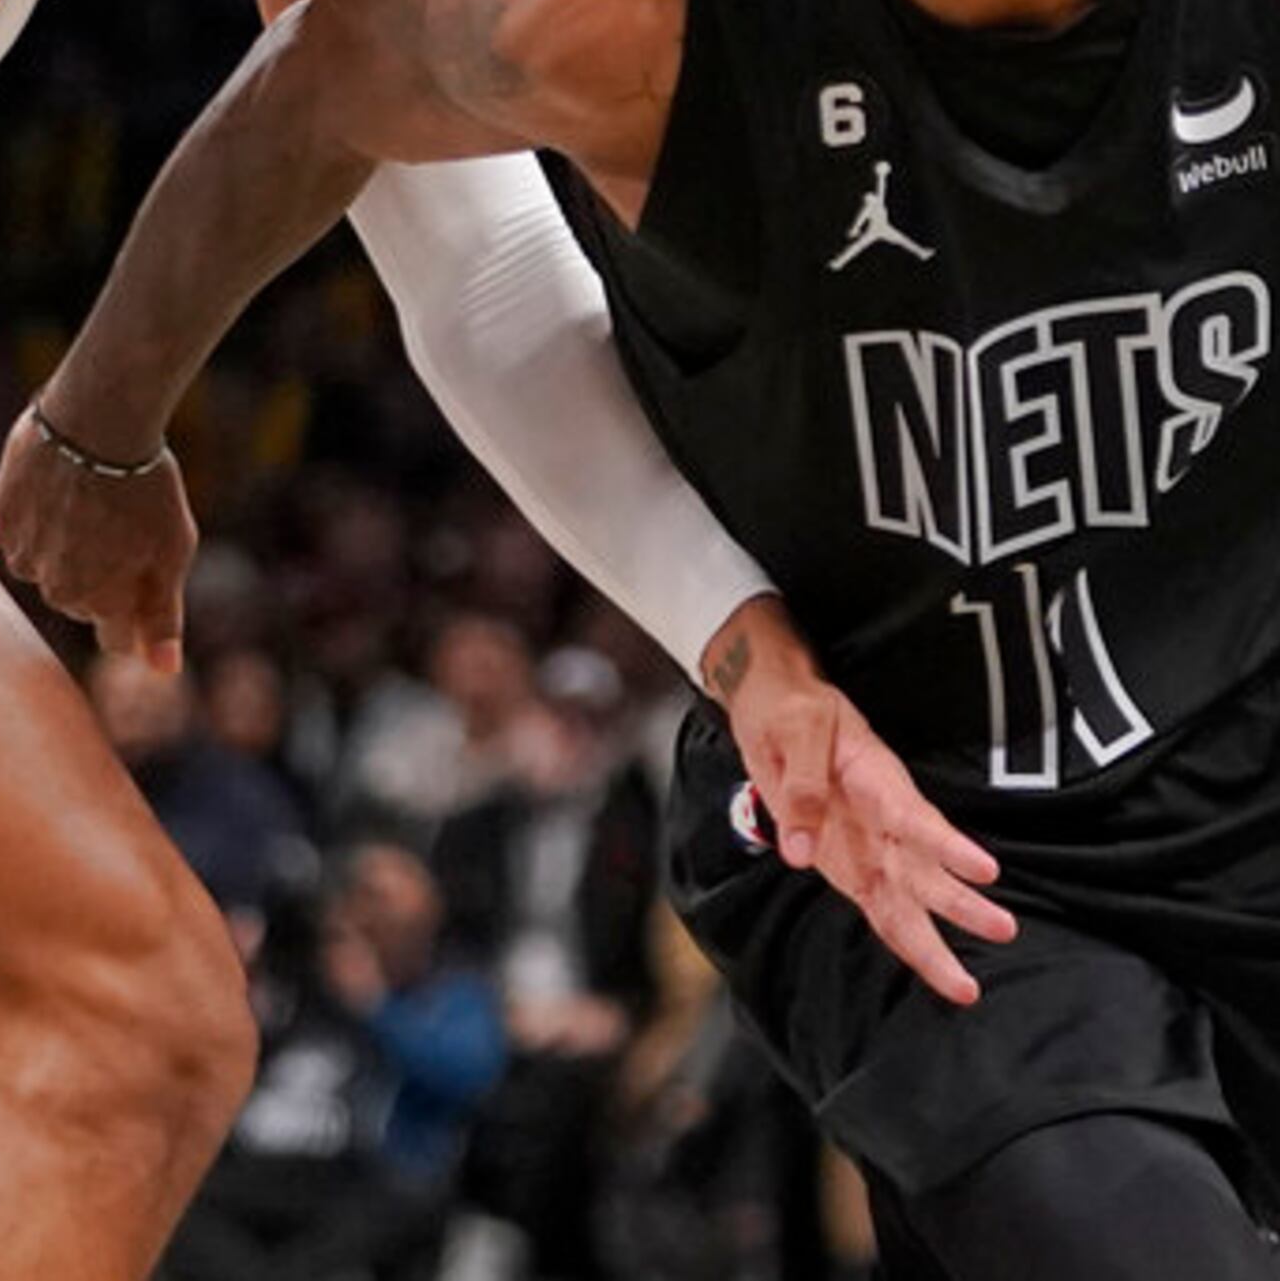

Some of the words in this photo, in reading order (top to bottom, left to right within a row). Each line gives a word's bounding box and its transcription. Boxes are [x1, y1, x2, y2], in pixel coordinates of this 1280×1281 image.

[817, 82, 867, 147] 6
[843, 270, 1271, 567] NETS
[950, 562, 1156, 790] 11
